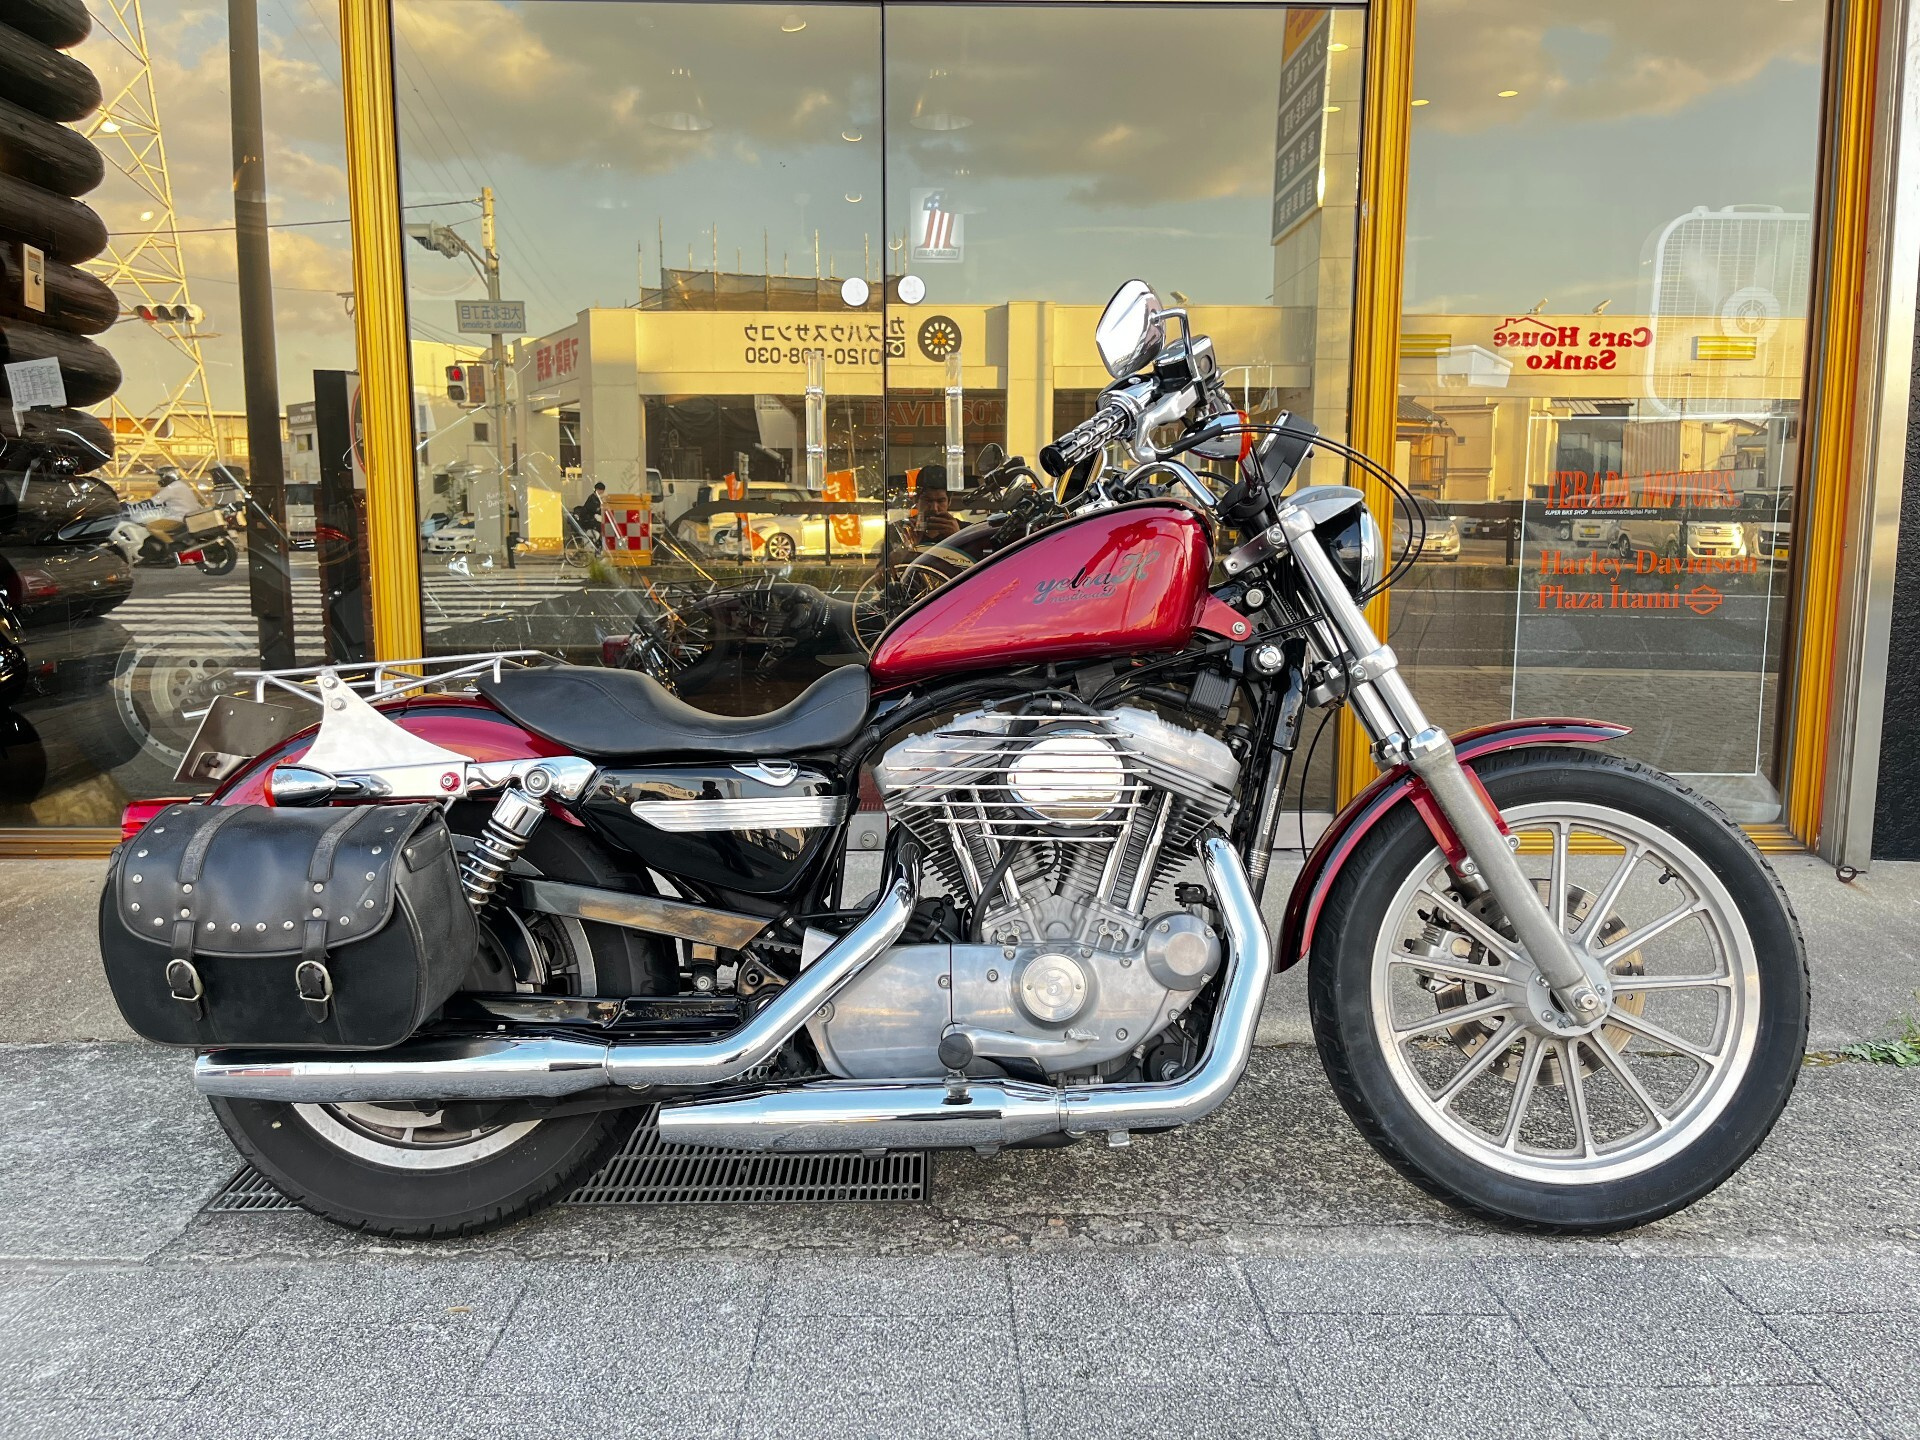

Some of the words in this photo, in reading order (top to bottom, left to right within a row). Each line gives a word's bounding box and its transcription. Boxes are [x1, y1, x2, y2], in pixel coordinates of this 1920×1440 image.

[1546, 470, 1633, 509] TERADA
[1538, 549, 1757, 582] Harley-Davidson
[1537, 584, 1605, 609] Plaza
[1608, 583, 1681, 609] Itami
